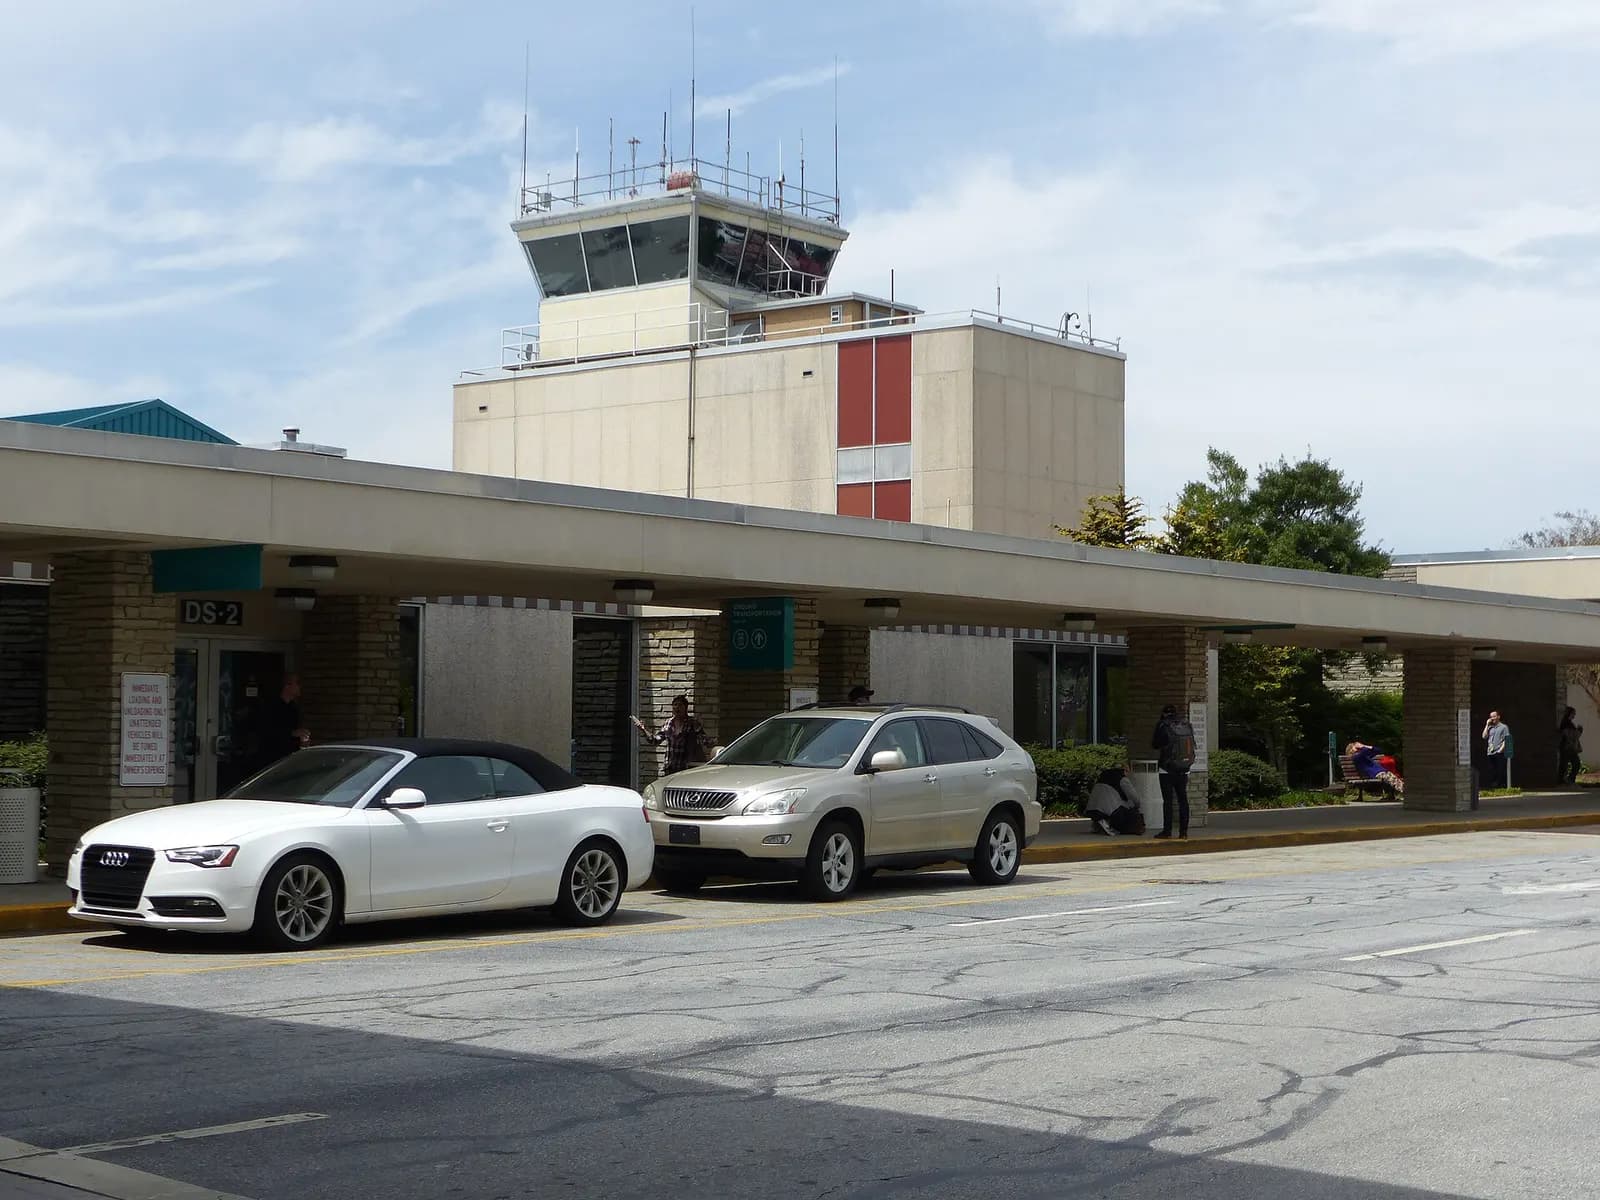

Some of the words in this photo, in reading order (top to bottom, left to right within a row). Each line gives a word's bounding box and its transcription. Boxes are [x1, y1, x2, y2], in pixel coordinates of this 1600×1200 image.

[132, 684, 159, 693] IMMEDIATE
[128, 695, 150, 704] LOADING
[151, 695, 162, 704] AND
[128, 730, 151, 739] VEHICLES
[132, 742, 140, 751] BE
[145, 765, 165, 774] EXPENSE
